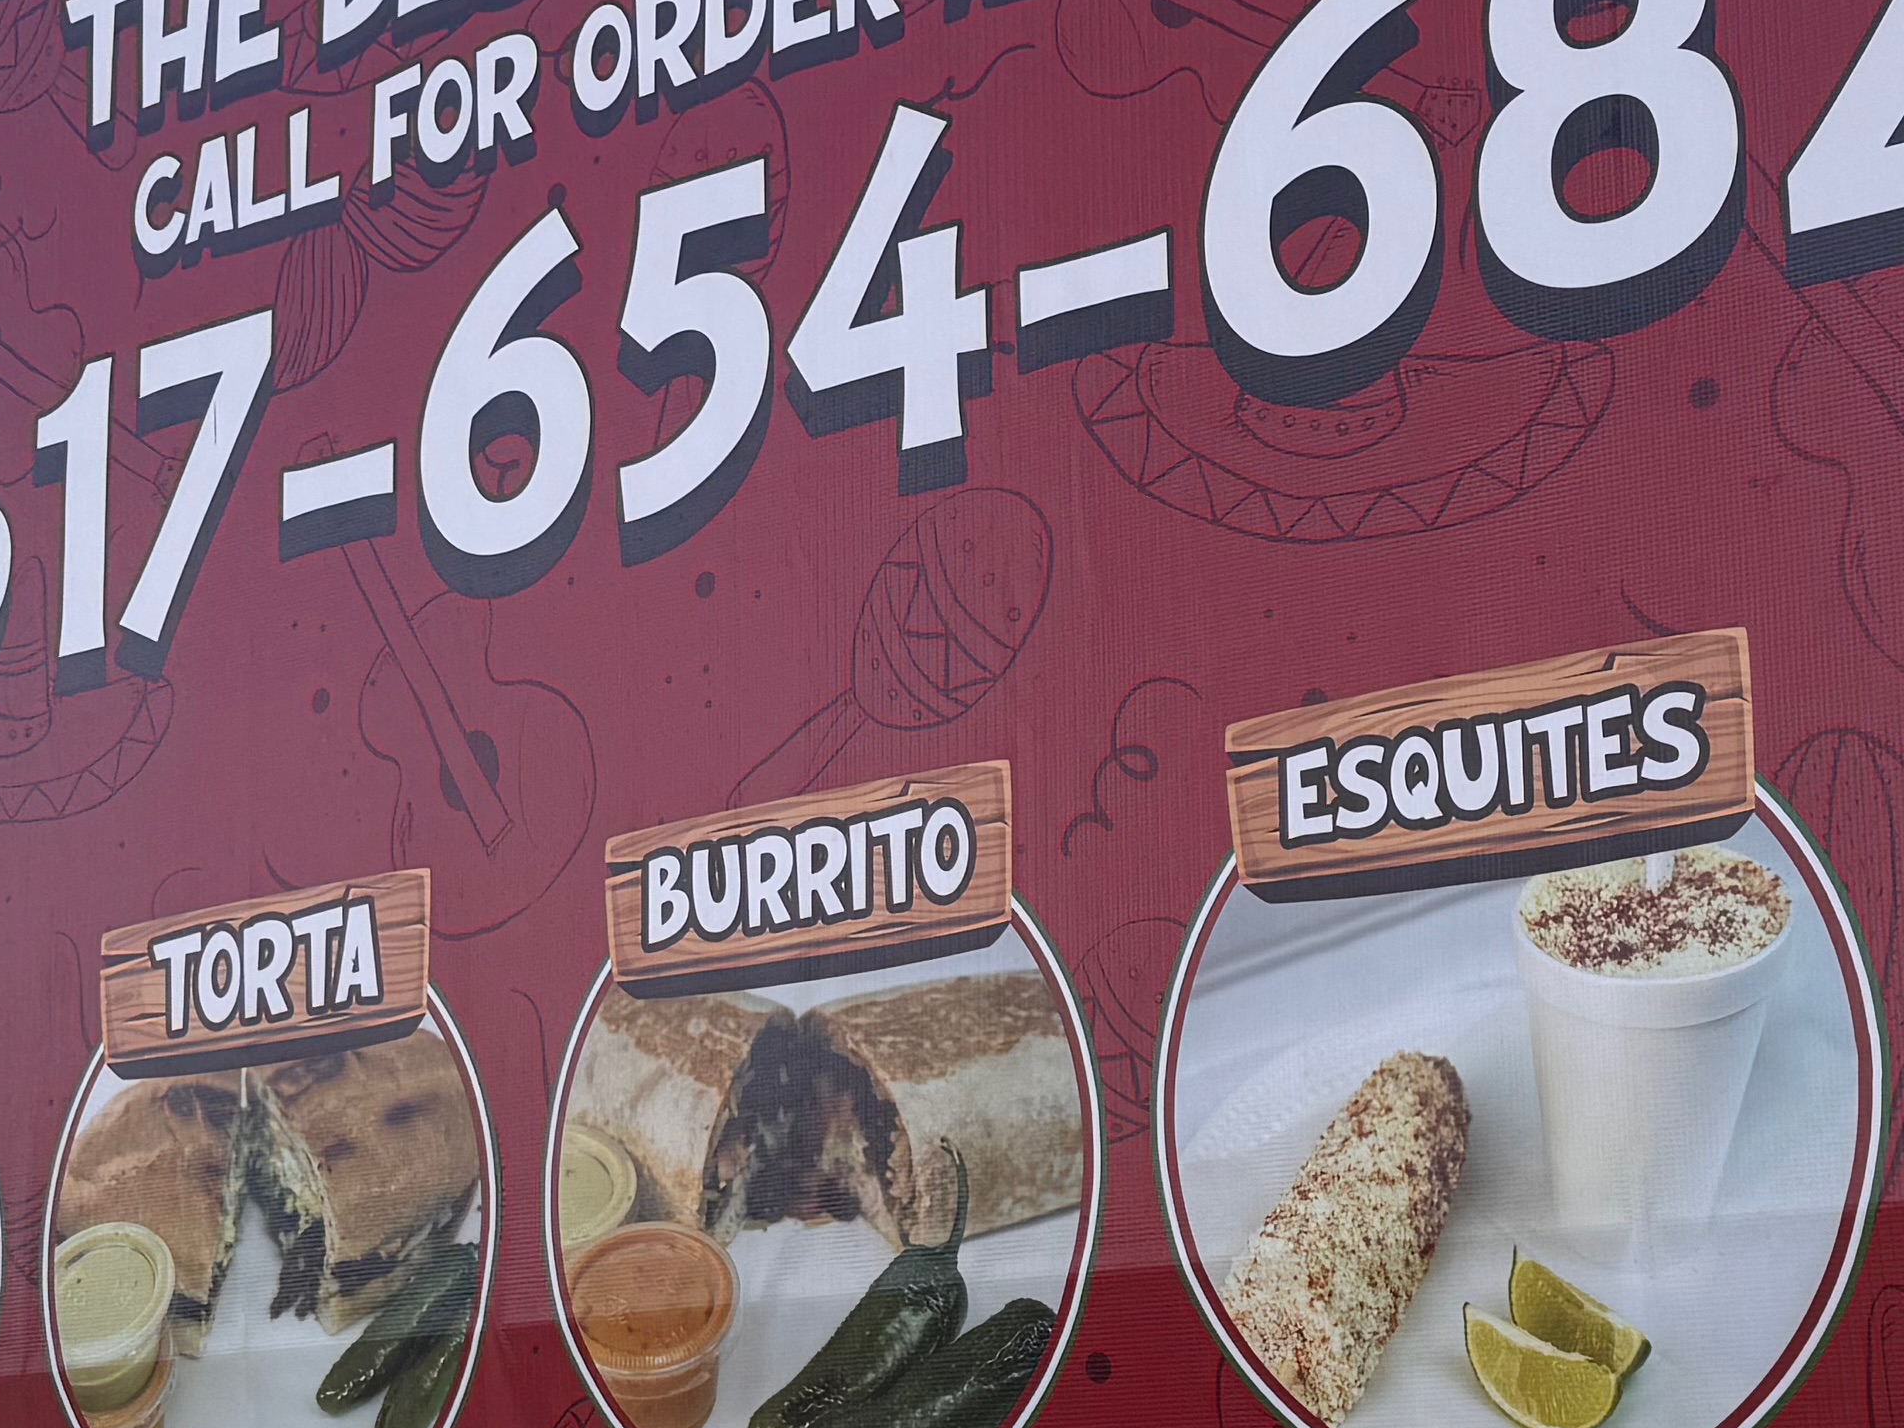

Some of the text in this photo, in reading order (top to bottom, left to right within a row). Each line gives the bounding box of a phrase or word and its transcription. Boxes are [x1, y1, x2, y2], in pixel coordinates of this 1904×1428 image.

[135, 109, 339, 254] CALL
[373, 35, 537, 183] FOR
[1287, 692, 1699, 838] ESQUITES
[649, 807, 968, 943] BURRITO
[154, 904, 378, 1030] TORTA
